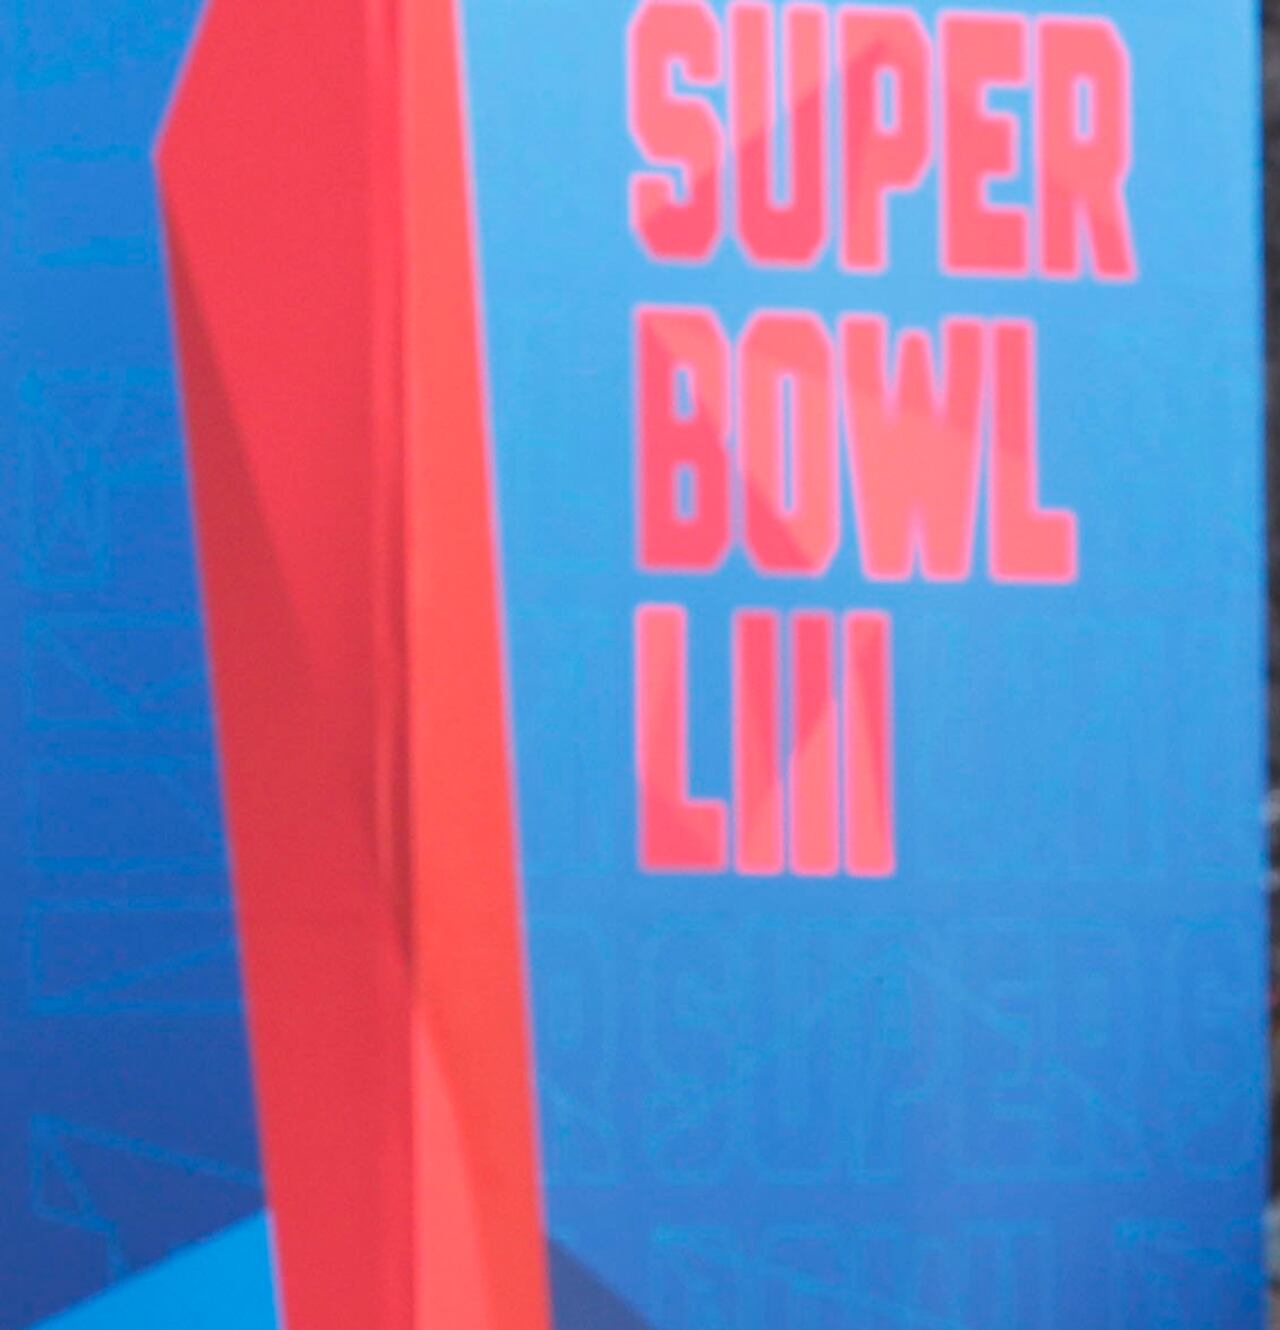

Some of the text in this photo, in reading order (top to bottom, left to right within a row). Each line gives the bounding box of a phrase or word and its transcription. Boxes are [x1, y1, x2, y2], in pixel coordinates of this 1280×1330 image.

[628, 0, 1138, 282] SUPER
[633, 304, 1077, 584] BOWL
[634, 603, 896, 878] LIII
